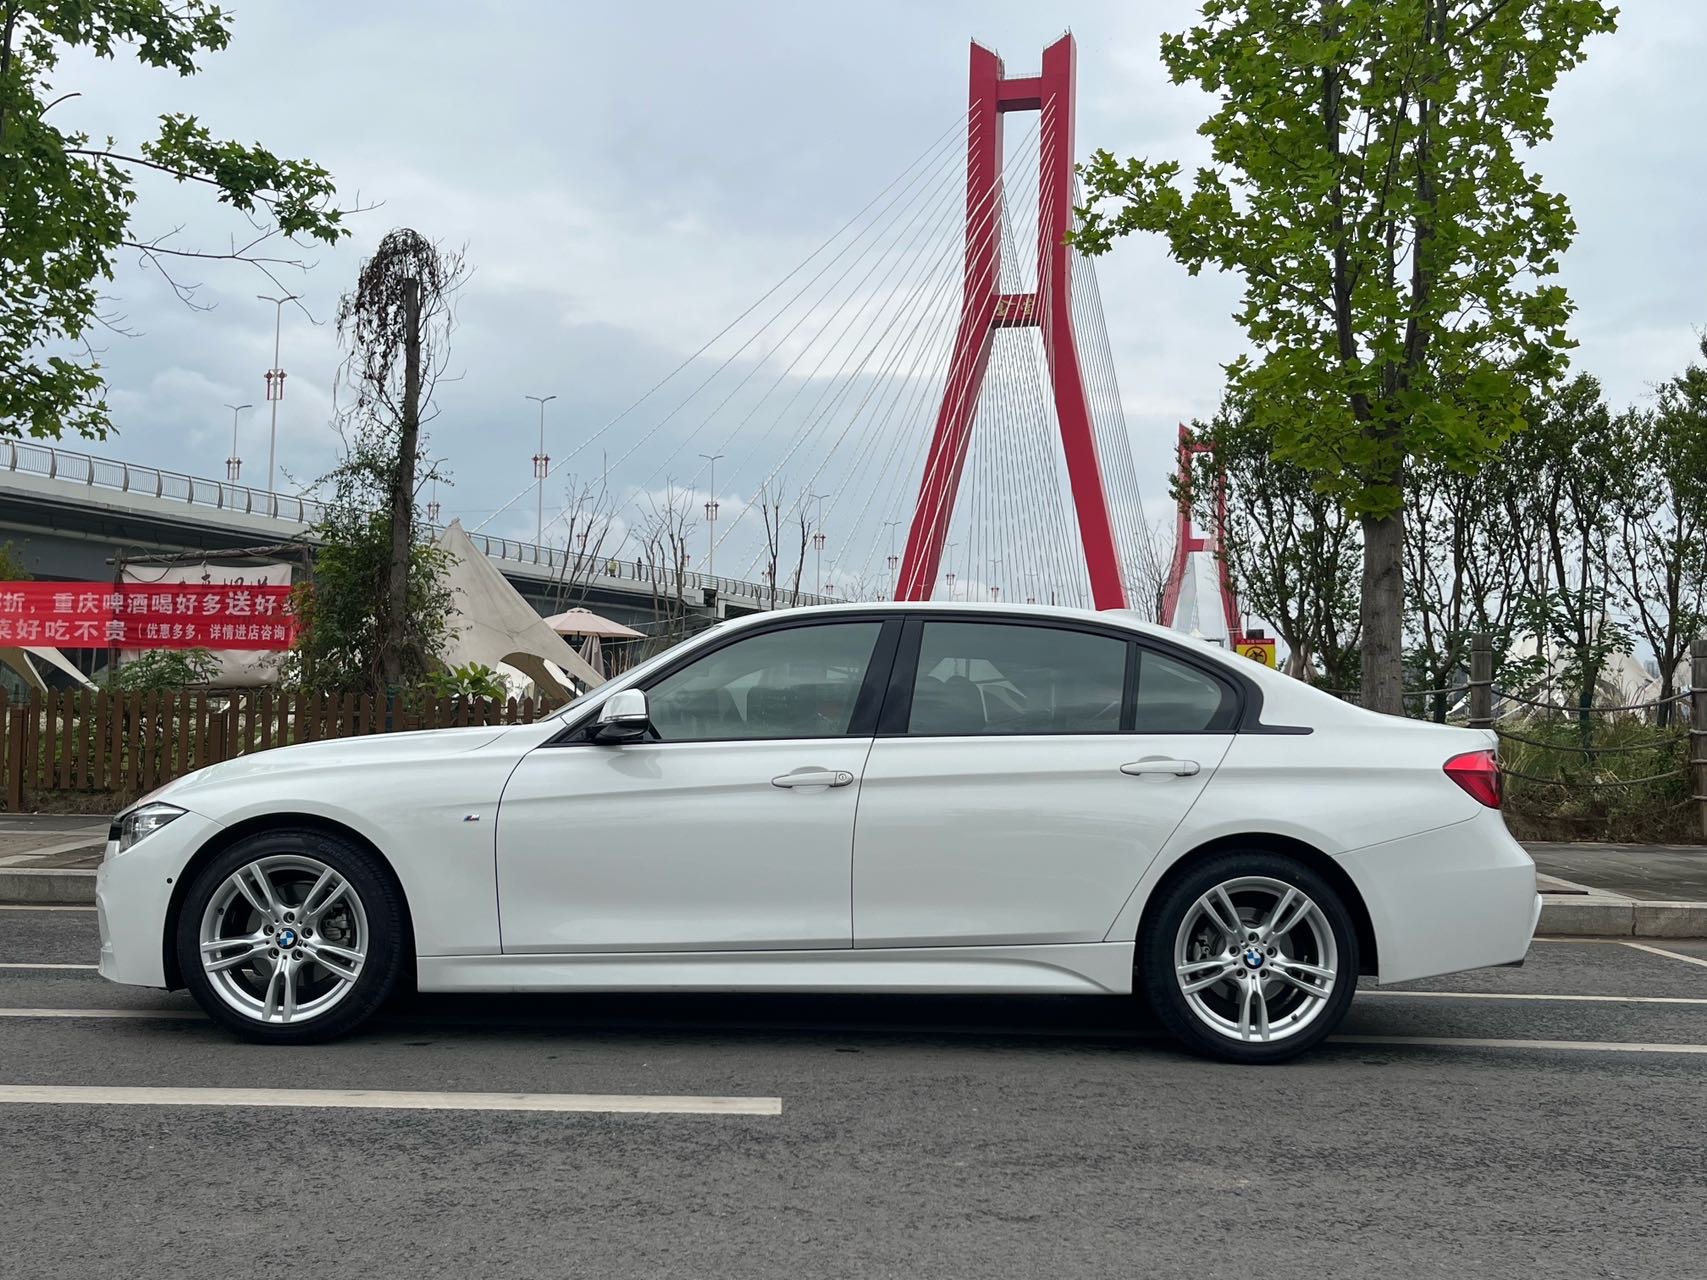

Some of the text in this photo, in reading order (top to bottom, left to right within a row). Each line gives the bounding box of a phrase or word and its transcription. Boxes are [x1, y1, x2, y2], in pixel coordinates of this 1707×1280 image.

[0, 591, 293, 616] 折，重庆啤酒喝好多送好
